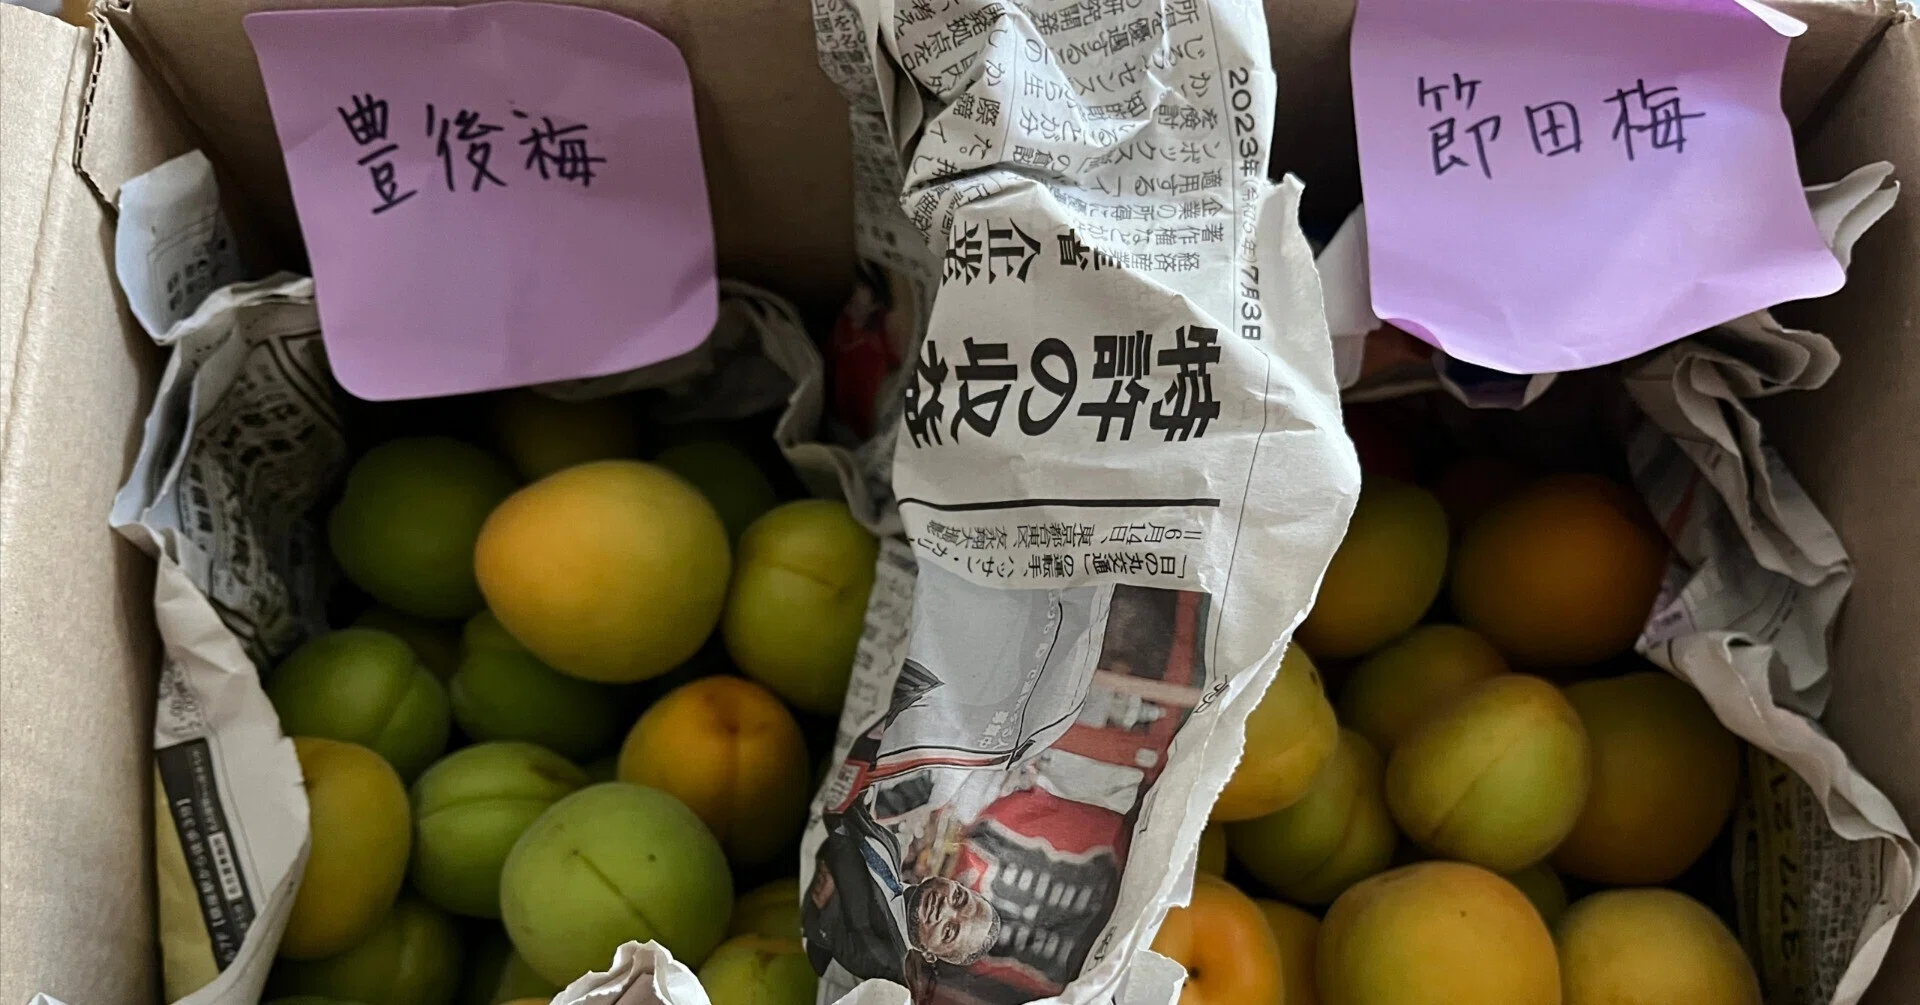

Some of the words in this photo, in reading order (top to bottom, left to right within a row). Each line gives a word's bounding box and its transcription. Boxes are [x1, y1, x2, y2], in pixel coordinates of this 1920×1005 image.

[338, 93, 607, 214] 豊後梅
[1417, 73, 1706, 179] 節田梅
